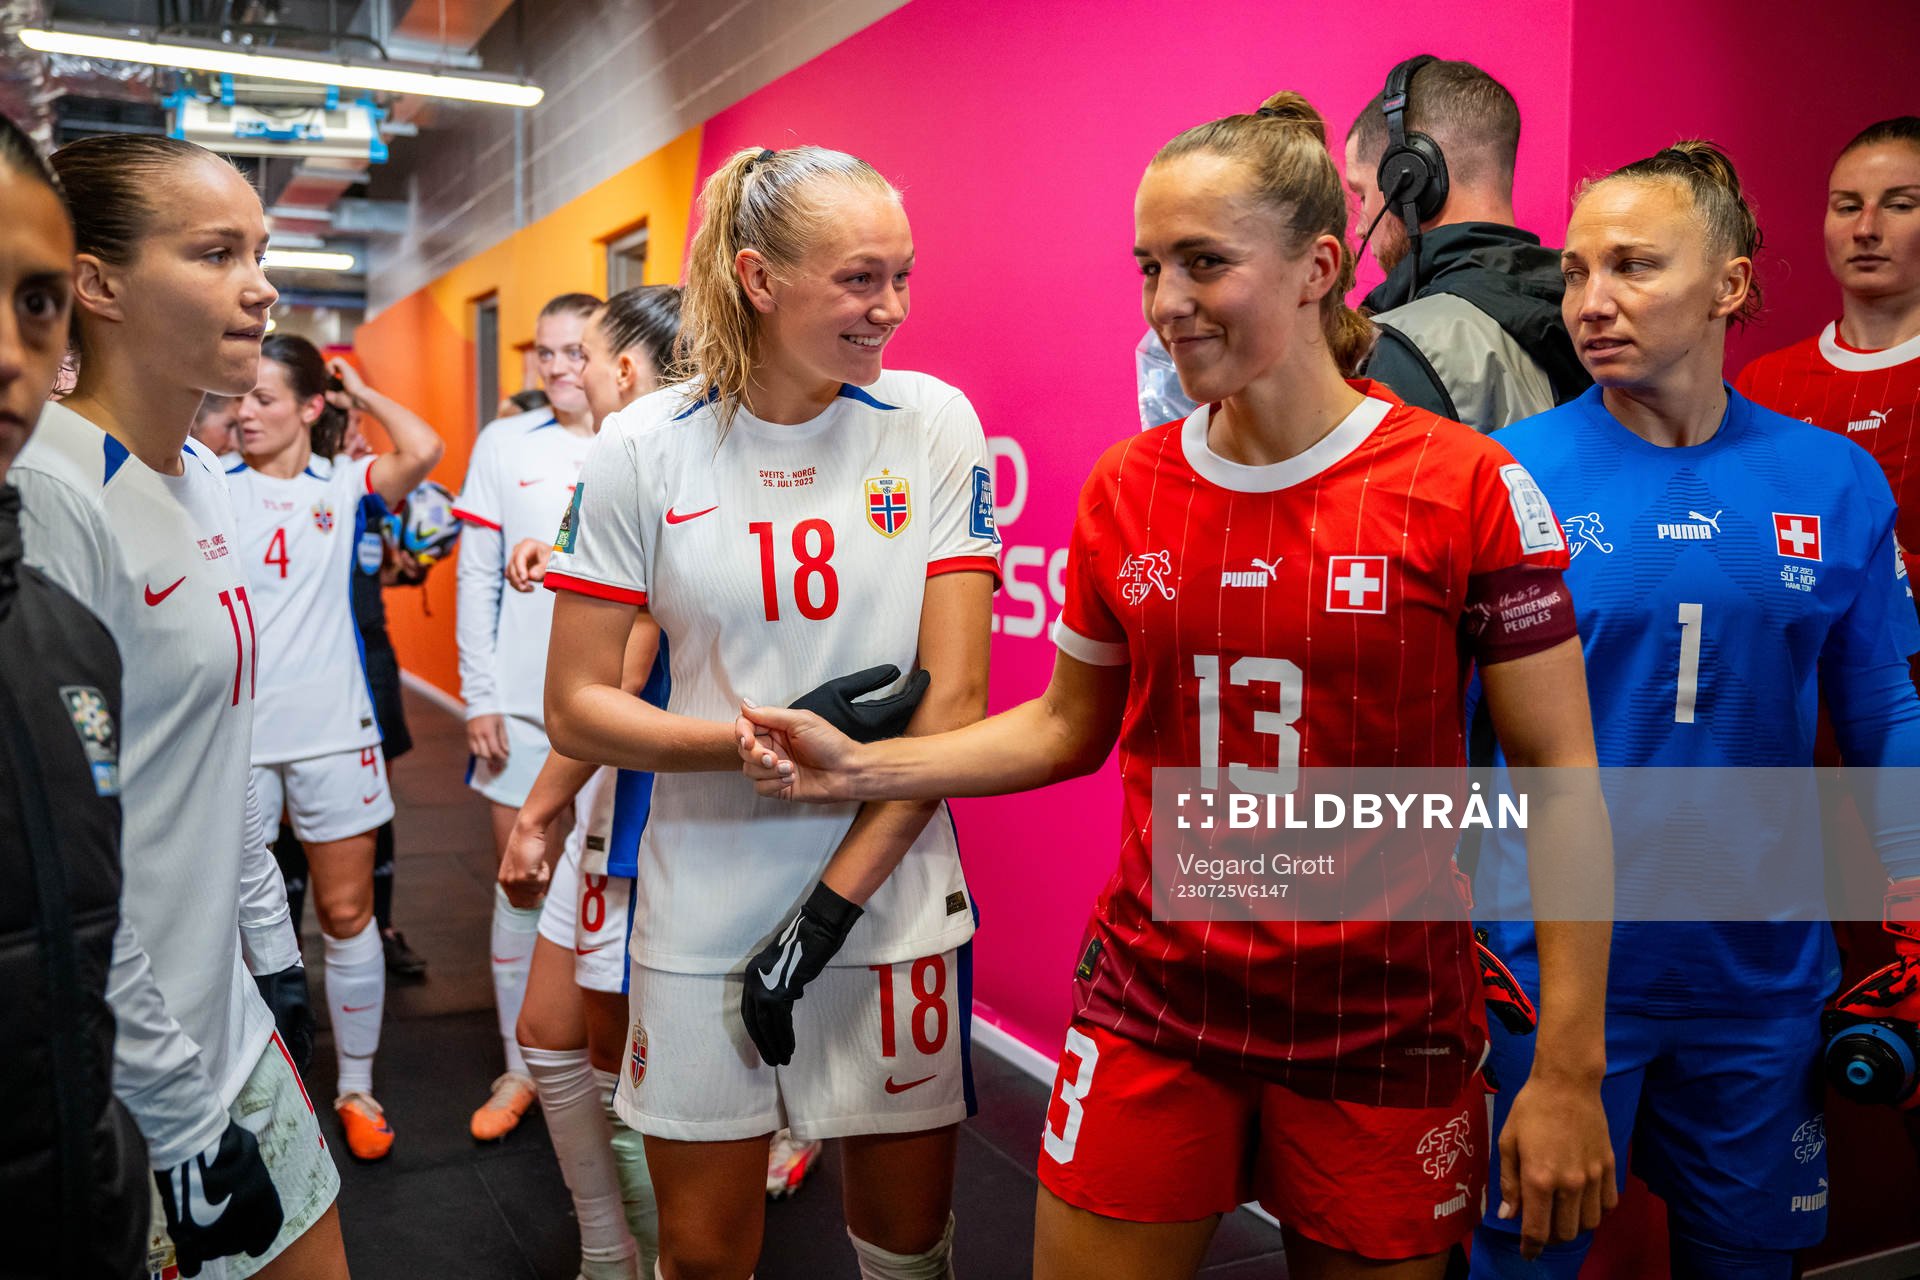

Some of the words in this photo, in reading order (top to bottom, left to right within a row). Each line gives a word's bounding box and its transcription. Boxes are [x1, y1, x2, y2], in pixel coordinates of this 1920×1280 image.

[1847, 417, 1881, 433] PUMA
[759, 470, 785, 479] SVEITS
[792, 466, 817, 479] NORGE
[763, 479, 775, 488] 25.
[777, 480, 793, 488] JULI
[794, 477, 814, 488] 2023
[1657, 524, 1712, 540] PUMA
[264, 527, 292, 579] 4
[748, 518, 840, 622] 18
[1221, 571, 1268, 588] PUMA
[1780, 571, 1794, 582] SUI
[1800, 574, 1816, 587] NOR
[1501, 590, 1561, 621] INDIGENOUS
[1504, 609, 1551, 634] PEOPLES
[218, 586, 256, 707] 11
[1674, 602, 1703, 723] 1
[1193, 654, 1304, 798] 13
[869, 953, 949, 1058] 18
[1042, 1026, 1100, 1165] 3
[1434, 1192, 1467, 1220] PUMA
